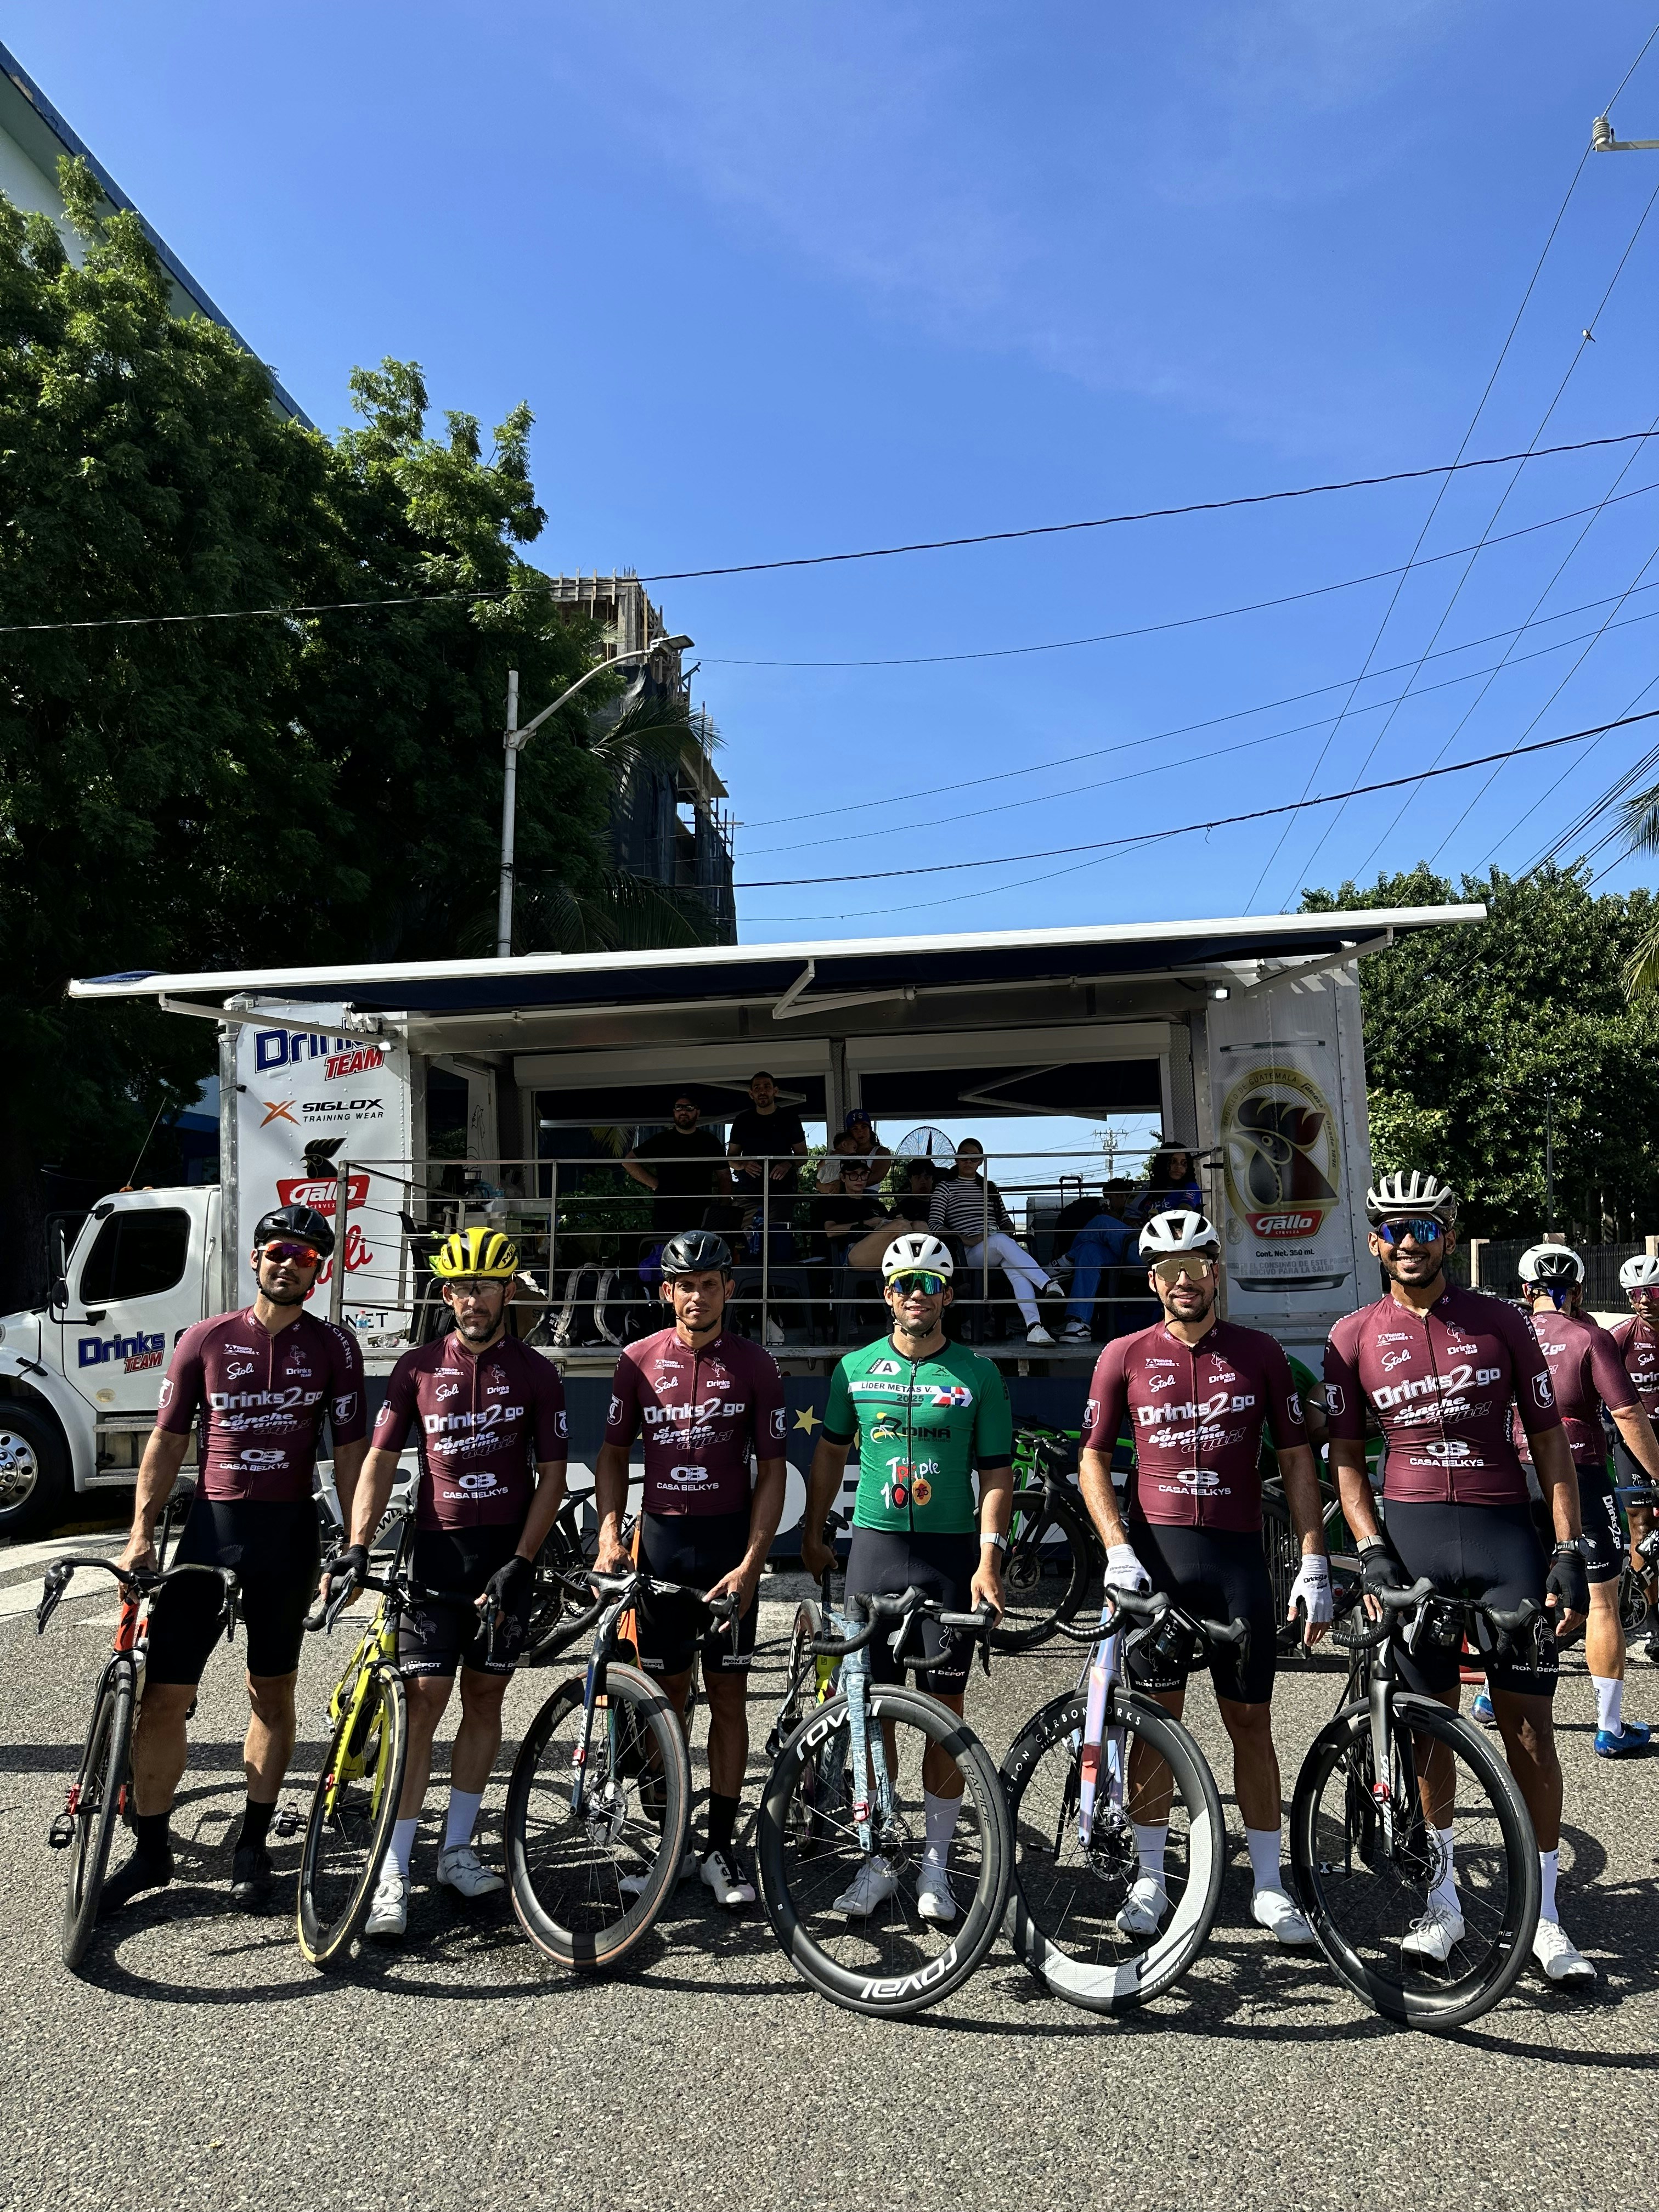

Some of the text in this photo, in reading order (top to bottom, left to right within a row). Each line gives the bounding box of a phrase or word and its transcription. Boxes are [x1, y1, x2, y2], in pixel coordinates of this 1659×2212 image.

[324, 1045, 385, 1081] TEAM
[302, 1098, 385, 1113] SIGLOX
[1223, 1072, 1297, 1126] ORGULLO DE GUATEMALA
[303, 1111, 384, 1122] TRAINING WEAR
[1325, 1120, 1335, 1147] desde
[1256, 1214, 1313, 1234] Gallo
[1259, 1261, 1296, 1269] CONSUMO
[78, 1331, 165, 1368] Drinks
[332, 1327, 352, 1369] CHENET
[1447, 1344, 1477, 1355] Drinks
[124, 1350, 165, 1374] TEAM
[882, 1362, 893, 1373] A
[1381, 1349, 1412, 1372] Stoli
[1638, 1353, 1655, 1366] Stoli
[227, 1362, 255, 1380] Stoli
[1209, 1372, 1235, 1384] Drinks
[487, 1385, 510, 1395] Drinks
[654, 1376, 679, 1393] Stoli
[861, 1381, 885, 1390] LÍDER
[1149, 1374, 1176, 1392] Stoli
[1372, 1364, 1502, 1410] Drinks2go
[210, 1386, 324, 1411] Drinks2go
[436, 1383, 459, 1402] Stoli
[896, 1394, 924, 1402] 2025
[643, 1397, 746, 1425] Drinks2go
[1137, 1392, 1256, 1426] Drinks2go
[1399, 1404, 1413, 1414] el
[1425, 1402, 1471, 1420] arma
[253, 1419, 298, 1429] arma
[424, 1403, 524, 1434] Drinks2go
[652, 1425, 712, 1441] bonche
[676, 1431, 715, 1442] arma
[1148, 1424, 1221, 1443] bonche
[1156, 1427, 1171, 1435] el
[1180, 1430, 1226, 1445] arma
[433, 1431, 495, 1452] bonche
[461, 1436, 499, 1452] arma
[219, 1462, 290, 1472] CASA BELKYS
[1409, 1458, 1484, 1467] CASA BELKYS
[443, 1487, 509, 1499] CASA BELKYS
[656, 1482, 719, 1491] CASA BELKYS
[1158, 1485, 1232, 1496] CASA BELKYS
[1602, 1494, 1621, 1549] Drinks2go
[1155, 1679, 1181, 1688] DEPOT
[960, 1764, 992, 1831] RAPIDE
[860, 1943, 958, 1999] roval
[1153, 1960, 1180, 1989] PIRELLI
